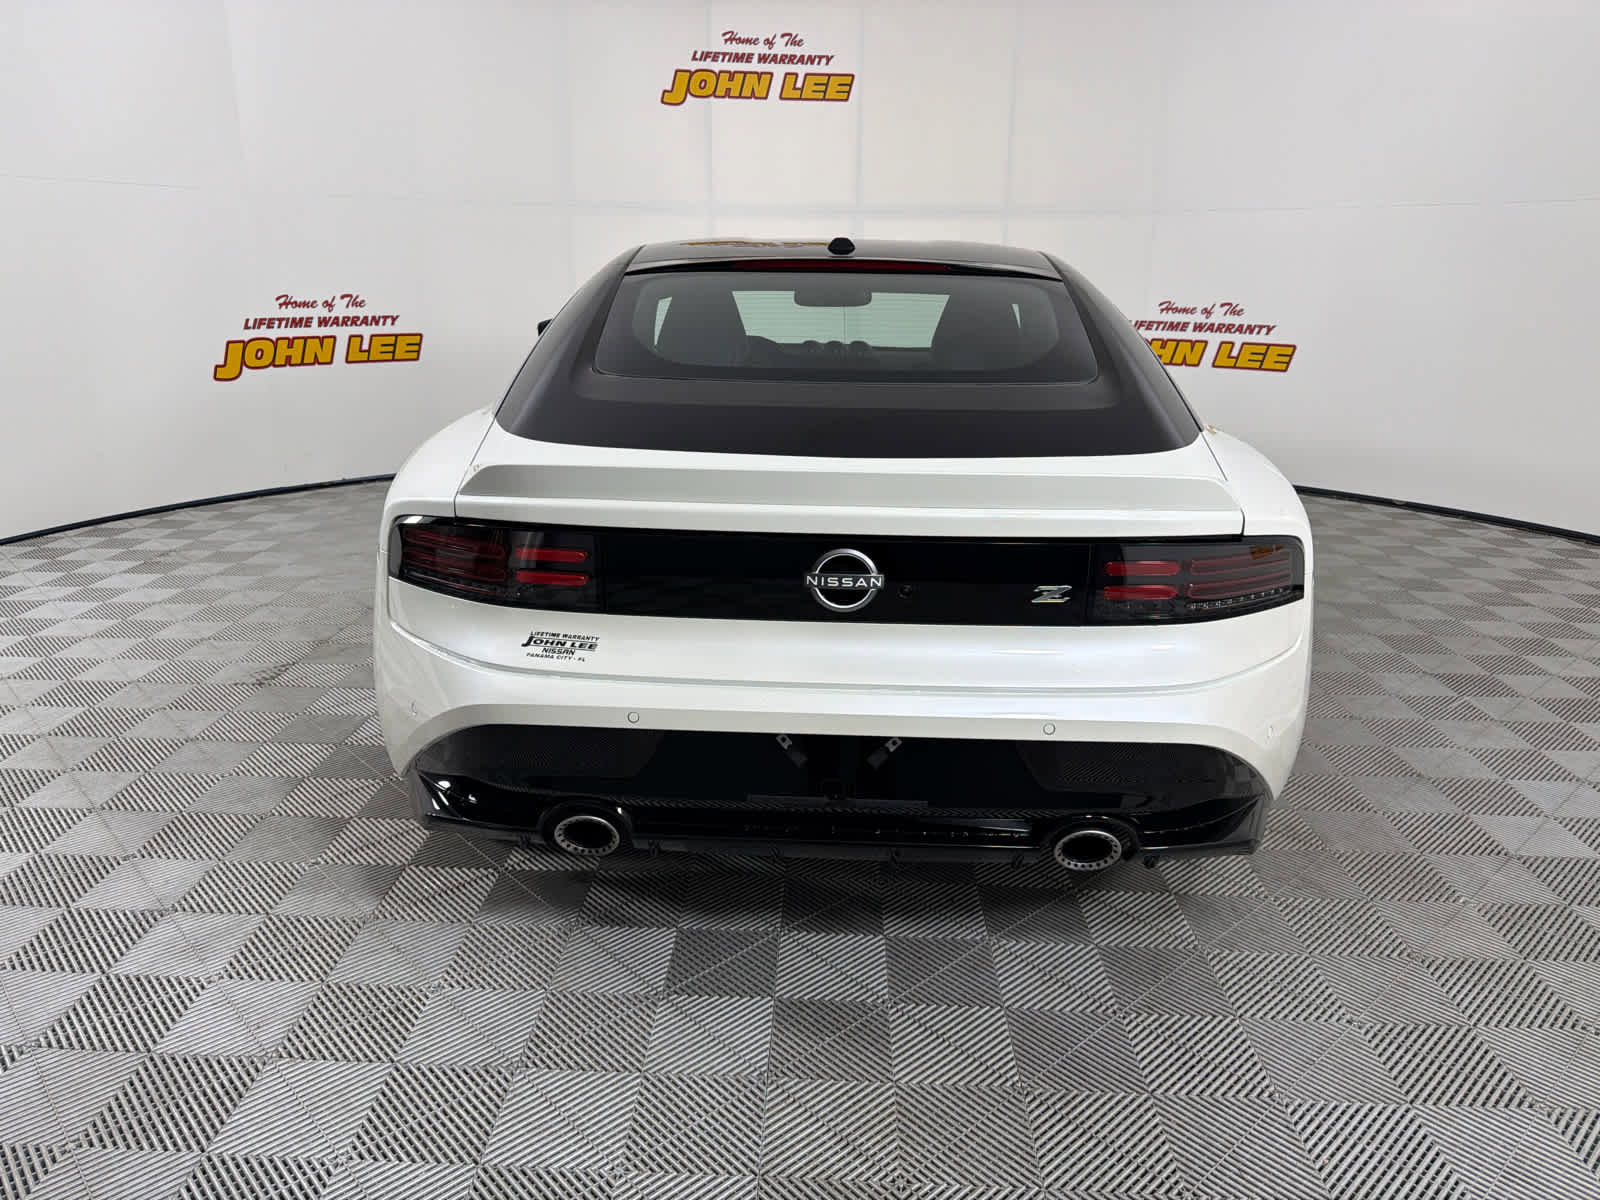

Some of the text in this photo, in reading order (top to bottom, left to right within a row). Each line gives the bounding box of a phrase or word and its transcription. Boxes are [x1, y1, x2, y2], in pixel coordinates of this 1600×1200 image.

[722, 30, 804, 50] Home of The
[691, 50, 834, 66] LIFETIME WARRANTY
[660, 69, 855, 106] JOHN LEE
[275, 293, 367, 312] Home of The
[1158, 300, 1245, 319] Home of The
[243, 315, 400, 330] LIFETIME WARRANTY
[1129, 319, 1277, 336] IFETIME WARRANTY
[213, 333, 423, 381] JOHN LEE
[1145, 338, 1297, 372] HN LEE
[806, 575, 882, 588] NISSAN
[1031, 585, 1072, 603] Z
[521, 635, 598, 650] JOHN LEE
[562, 633, 600, 641] WARRANTY
[541, 647, 576, 655] NISSAN
